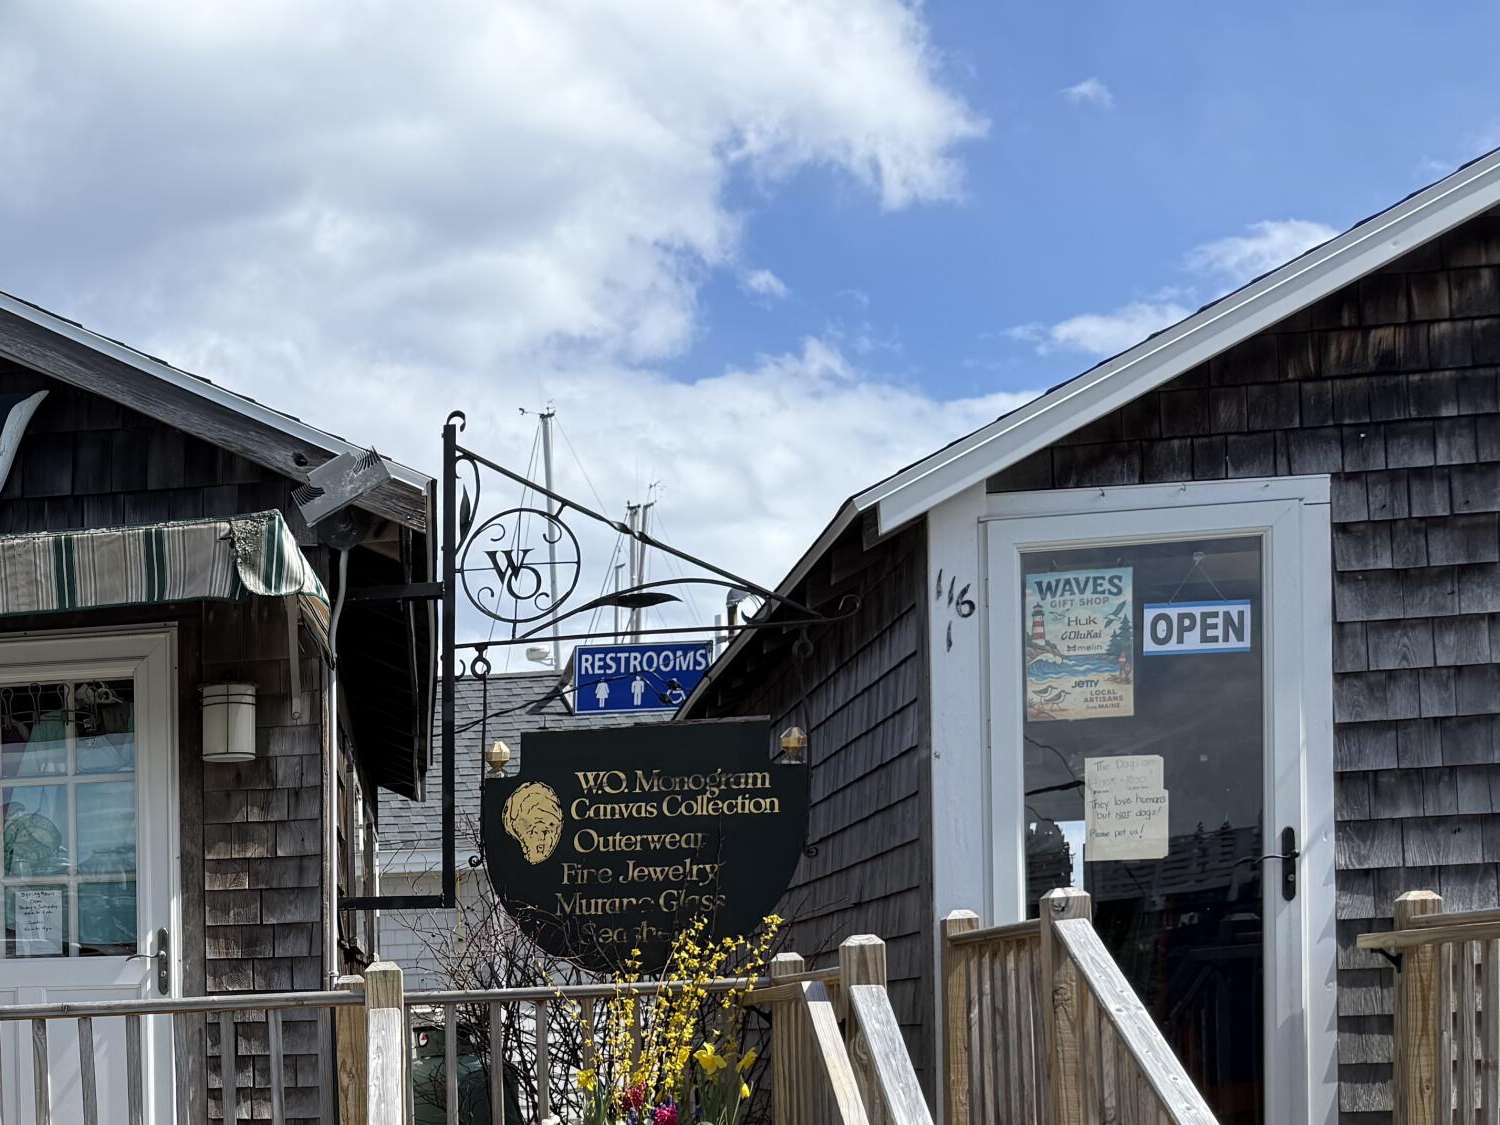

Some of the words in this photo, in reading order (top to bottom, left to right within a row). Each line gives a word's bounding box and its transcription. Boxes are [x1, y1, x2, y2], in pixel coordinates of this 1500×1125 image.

[1034, 574, 1123, 601] WAVES
[1050, 599, 1075, 609] GIFT
[1079, 596, 1109, 606] SHOP
[1067, 615, 1098, 627] Huk
[1150, 610, 1245, 646] OPEN
[581, 649, 707, 675] RESTROOMS
[1083, 695, 1124, 703] ARTISANS
[574, 770, 629, 795] W.O.
[632, 768, 772, 798] Monogram
[570, 798, 658, 821] Canvas
[662, 793, 780, 817] Collection
[1089, 799, 1109, 811] They
[1114, 795, 1132, 806] love
[1096, 810, 1111, 820] but
[1115, 828, 1126, 839] pet
[561, 862, 613, 885] Fine
[619, 857, 721, 887] Jewelry
